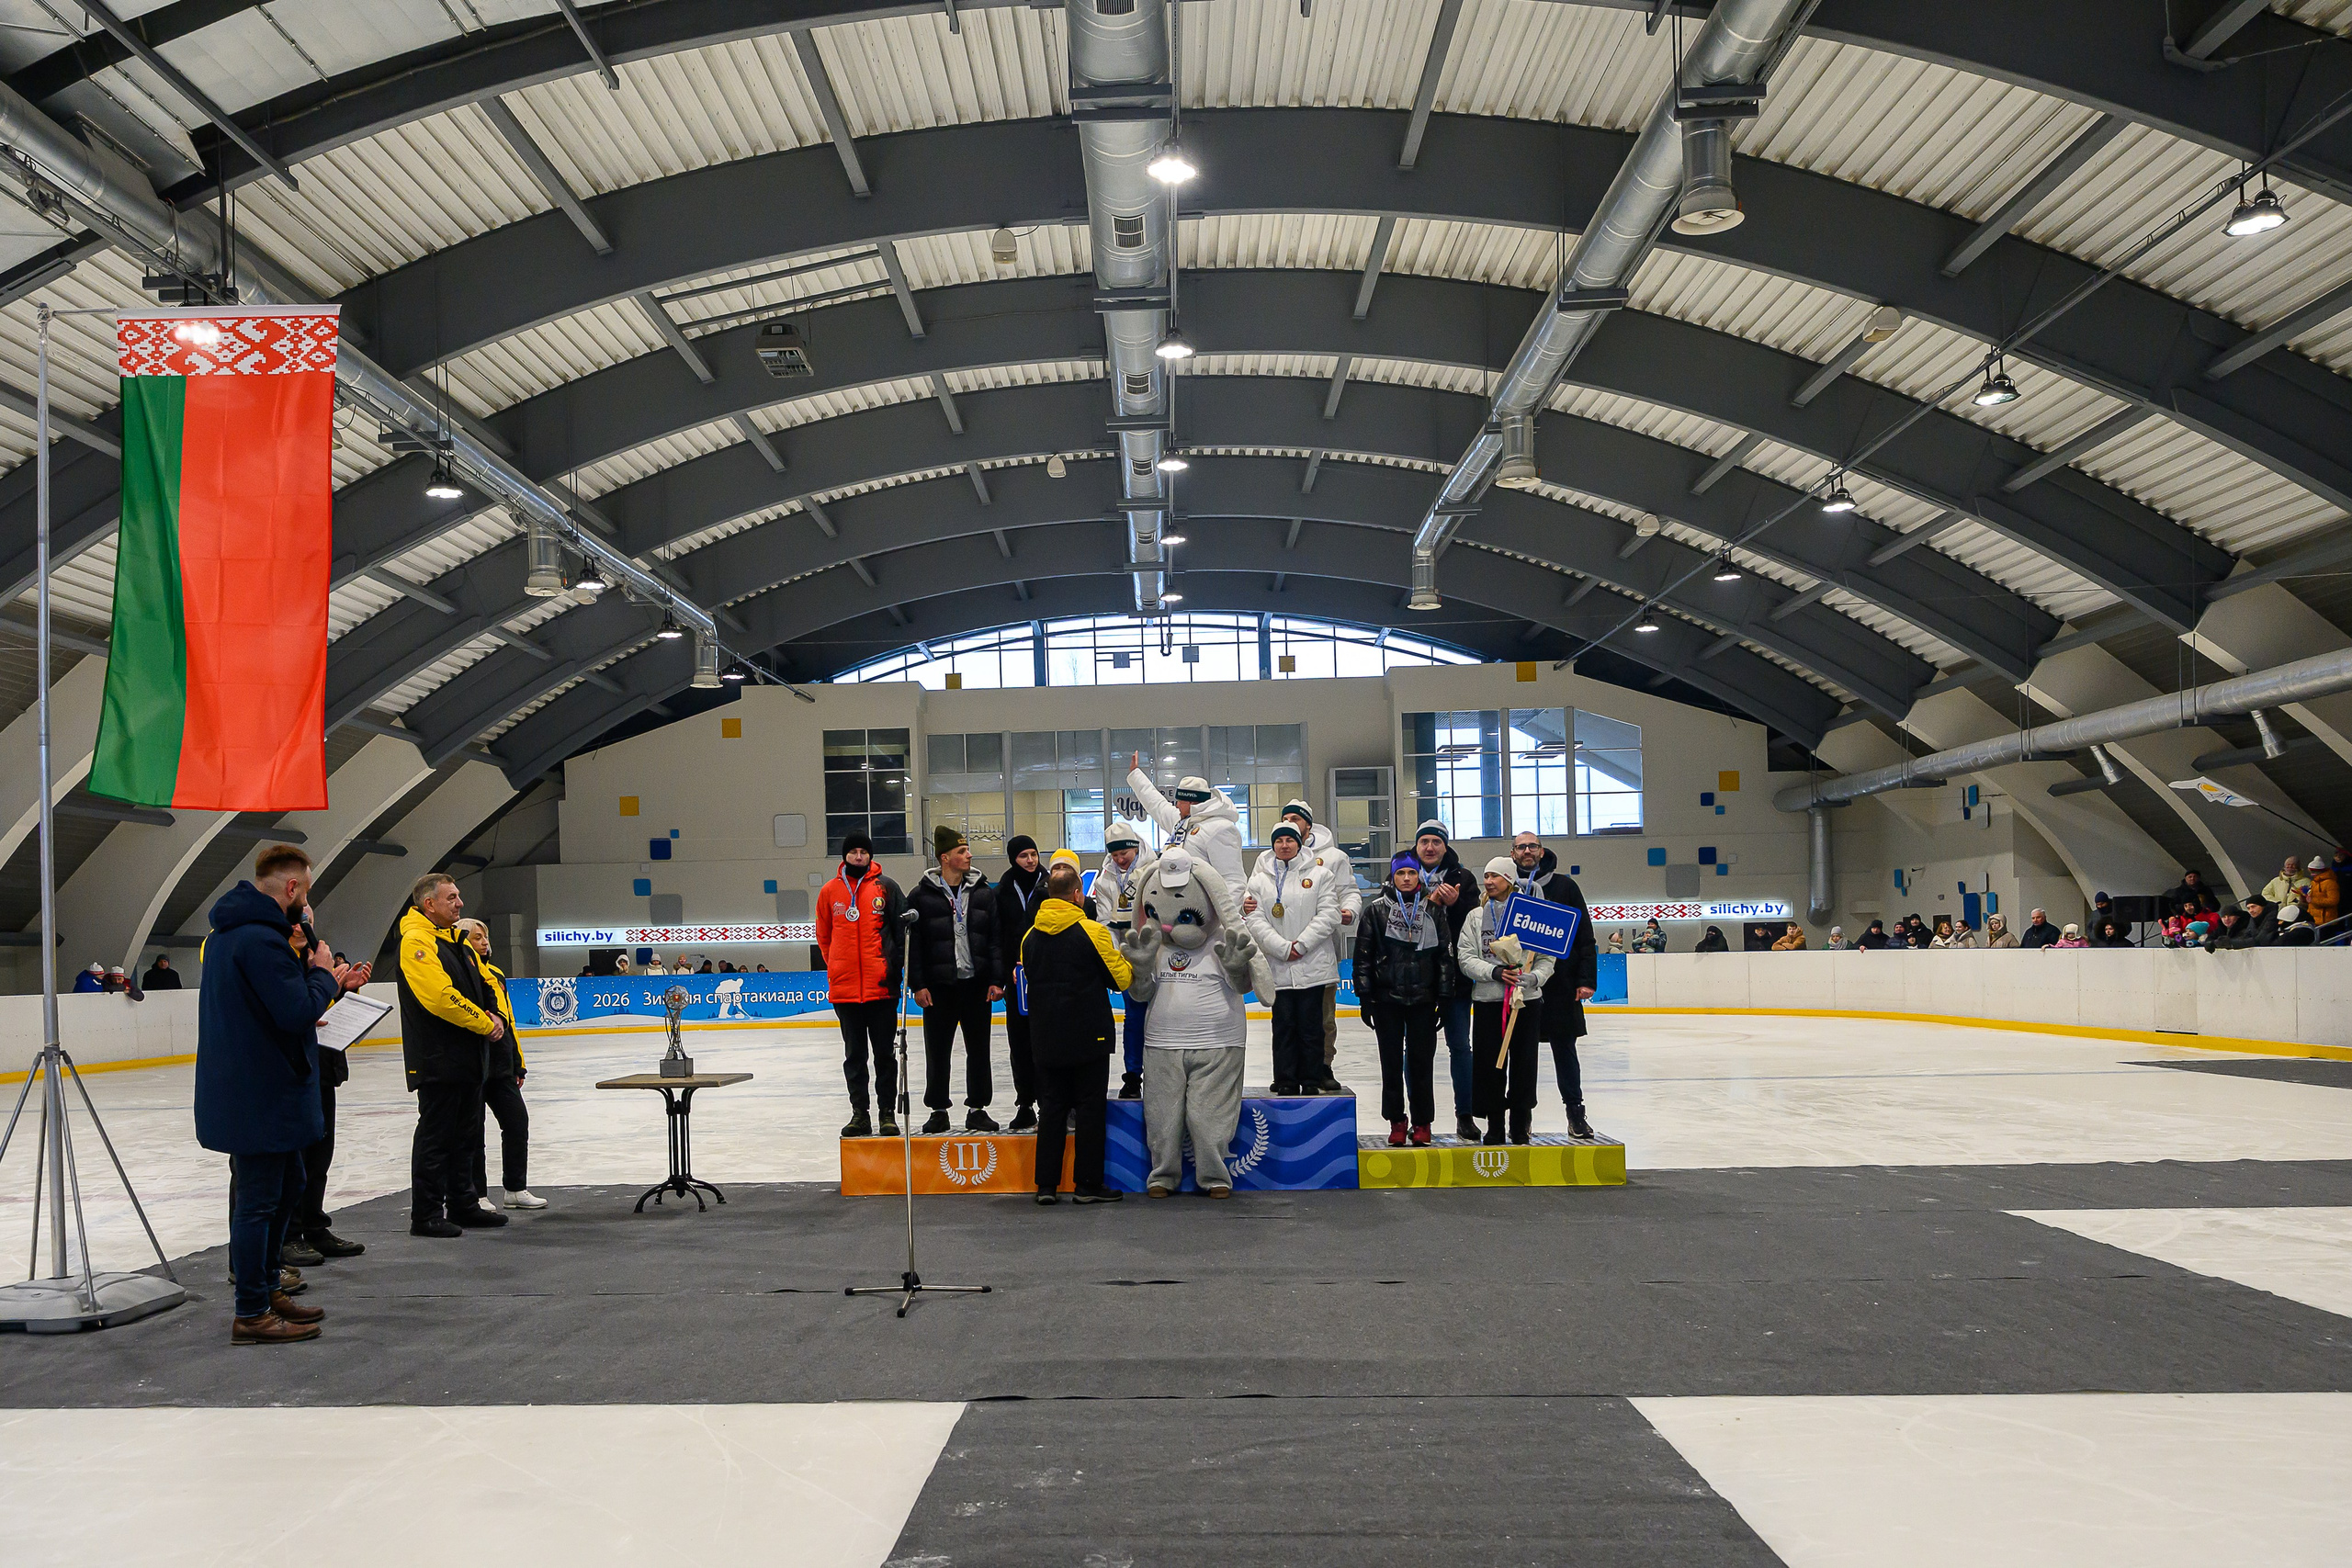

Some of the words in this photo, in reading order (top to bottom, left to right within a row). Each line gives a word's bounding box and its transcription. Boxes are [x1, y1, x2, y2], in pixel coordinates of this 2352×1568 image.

[1710, 903, 1784, 916] silichy.by
[1512, 912, 1565, 939] Единые
[544, 930, 614, 943] silichy.by
[449, 995, 480, 1020] BELARUS
[593, 992, 630, 1008] 2026
[706, 990, 804, 1005] спартакиада
